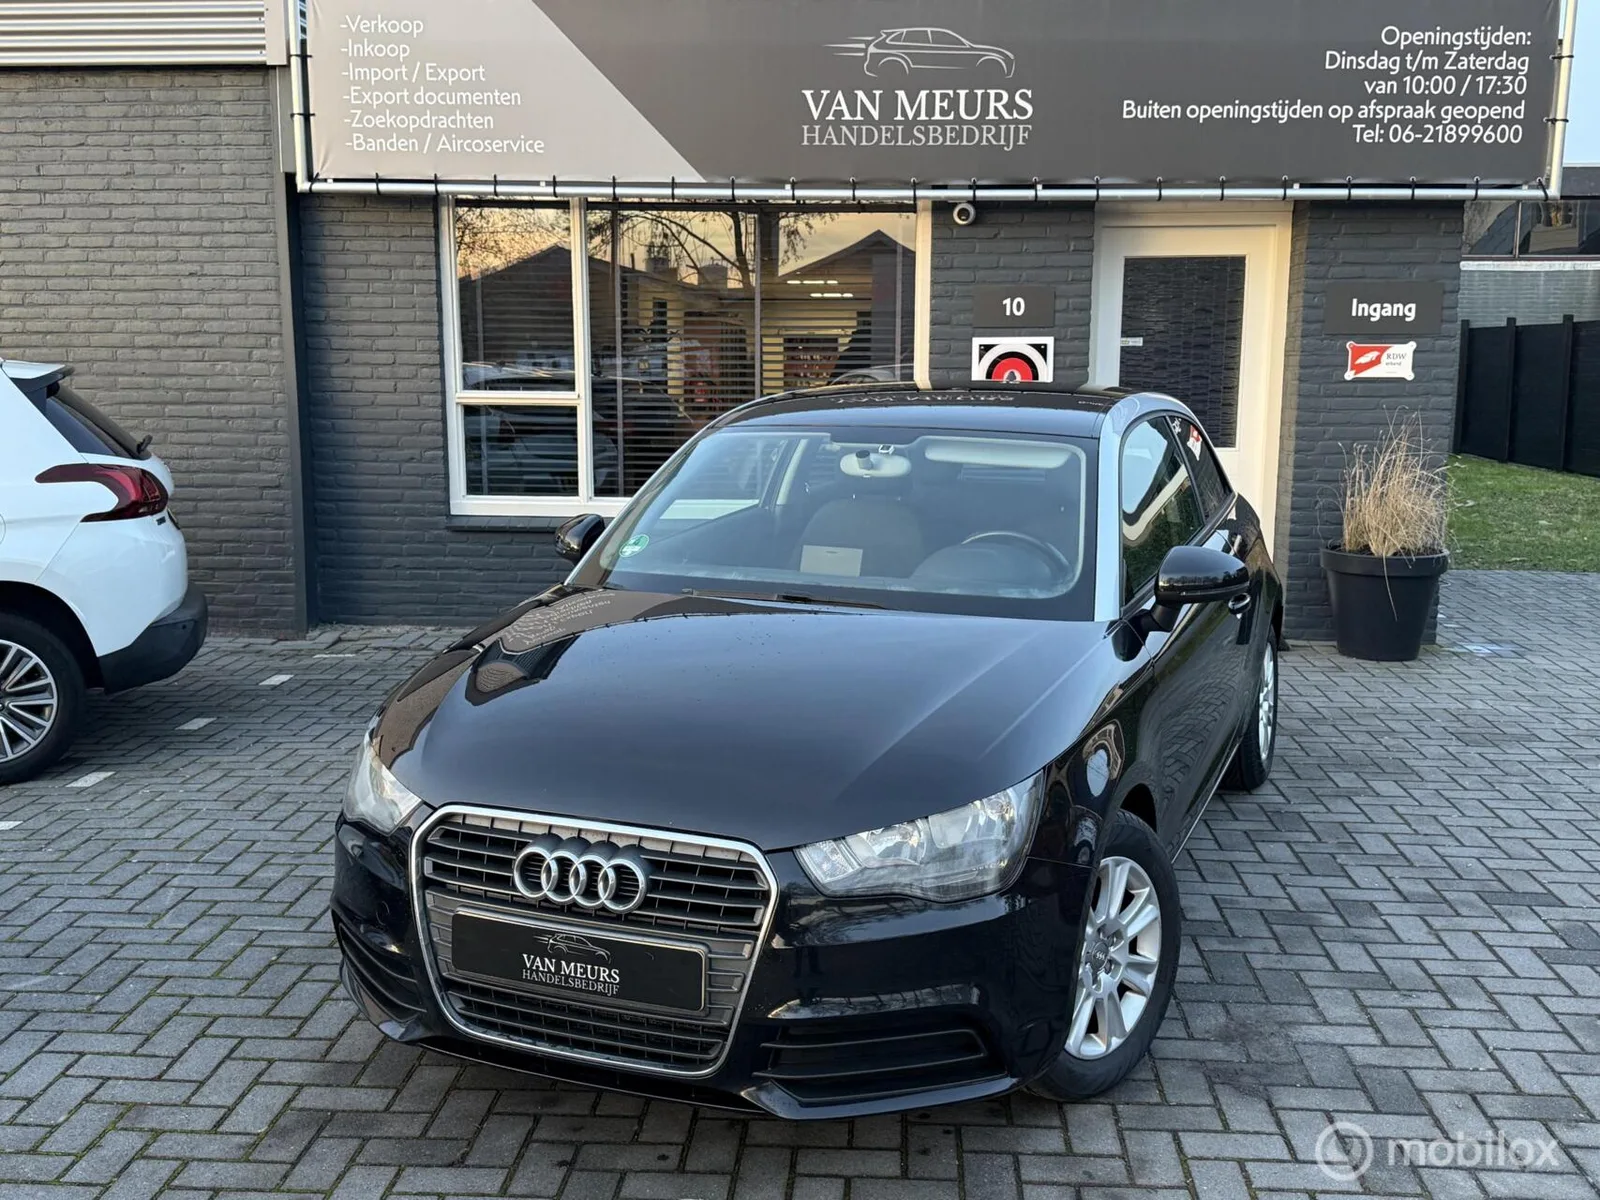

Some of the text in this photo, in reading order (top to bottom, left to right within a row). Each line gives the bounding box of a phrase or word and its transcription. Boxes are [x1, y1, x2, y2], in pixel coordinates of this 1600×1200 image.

[340, 15, 424, 36] -Verkoop
[1381, 25, 1532, 49] Openingstijden:
[340, 39, 410, 61] -Inkoop
[341, 62, 486, 85] -Import / Export
[1325, 50, 1529, 74] Dinsdag t/m Zaterdag
[1364, 75, 1527, 96] van 10:00 / 17:30
[342, 87, 521, 109] -Export documenten
[802, 88, 1034, 121] VAN MEURS
[343, 110, 494, 133] -Zoekopdrachten
[1122, 99, 1525, 124] Buiten openingstijden op afspraak geopend
[345, 133, 545, 154] -Banden / Aircoservice
[801, 124, 1032, 151] HANDELSBEDRIJF
[1352, 123, 1523, 144] Tel: 06-21899600
[1002, 297, 1025, 316] 10
[1351, 298, 1417, 322] Ingang
[522, 953, 620, 984] VAN MEURS
[522, 968, 620, 996] HANDELSBEDRIJF
